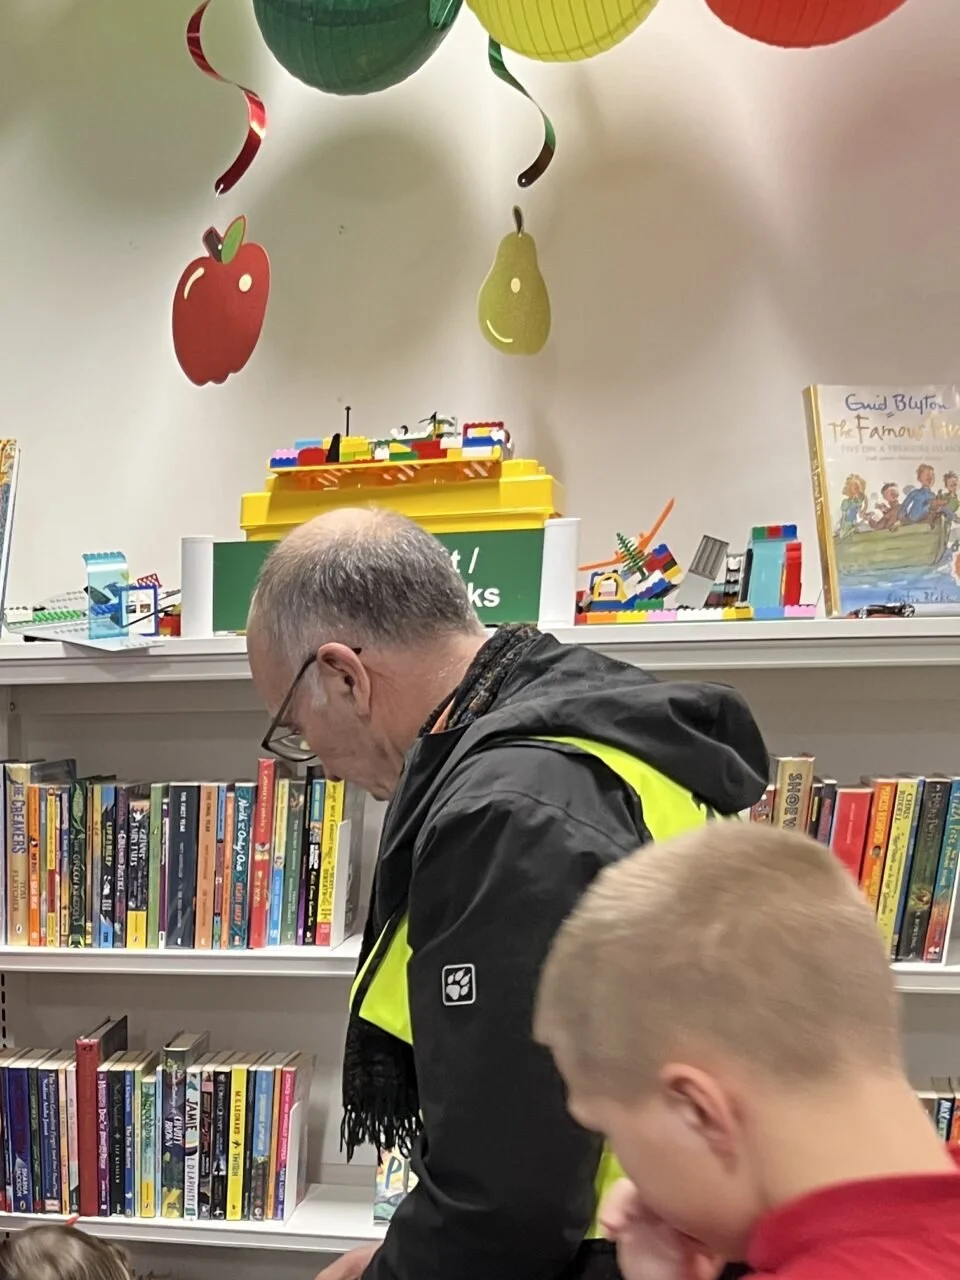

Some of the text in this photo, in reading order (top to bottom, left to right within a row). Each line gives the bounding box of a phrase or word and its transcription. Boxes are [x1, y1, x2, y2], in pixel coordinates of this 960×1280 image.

[844, 394, 950, 416] Enid Blyton
[828, 419, 853, 442] The
[854, 414, 924, 444] Famous
[878, 786, 889, 812] MARCUS
[895, 790, 905, 824] RIDDELL
[902, 793, 912, 820] CHRIS
[11, 782, 27, 854] THE CREAKERS
[186, 1098, 198, 1132] JAMIE
[164, 1120, 173, 1147] BROWN
[173, 1116, 182, 1145] CHARITY
[231, 1105, 241, 1177] LEONARD TWITCH
